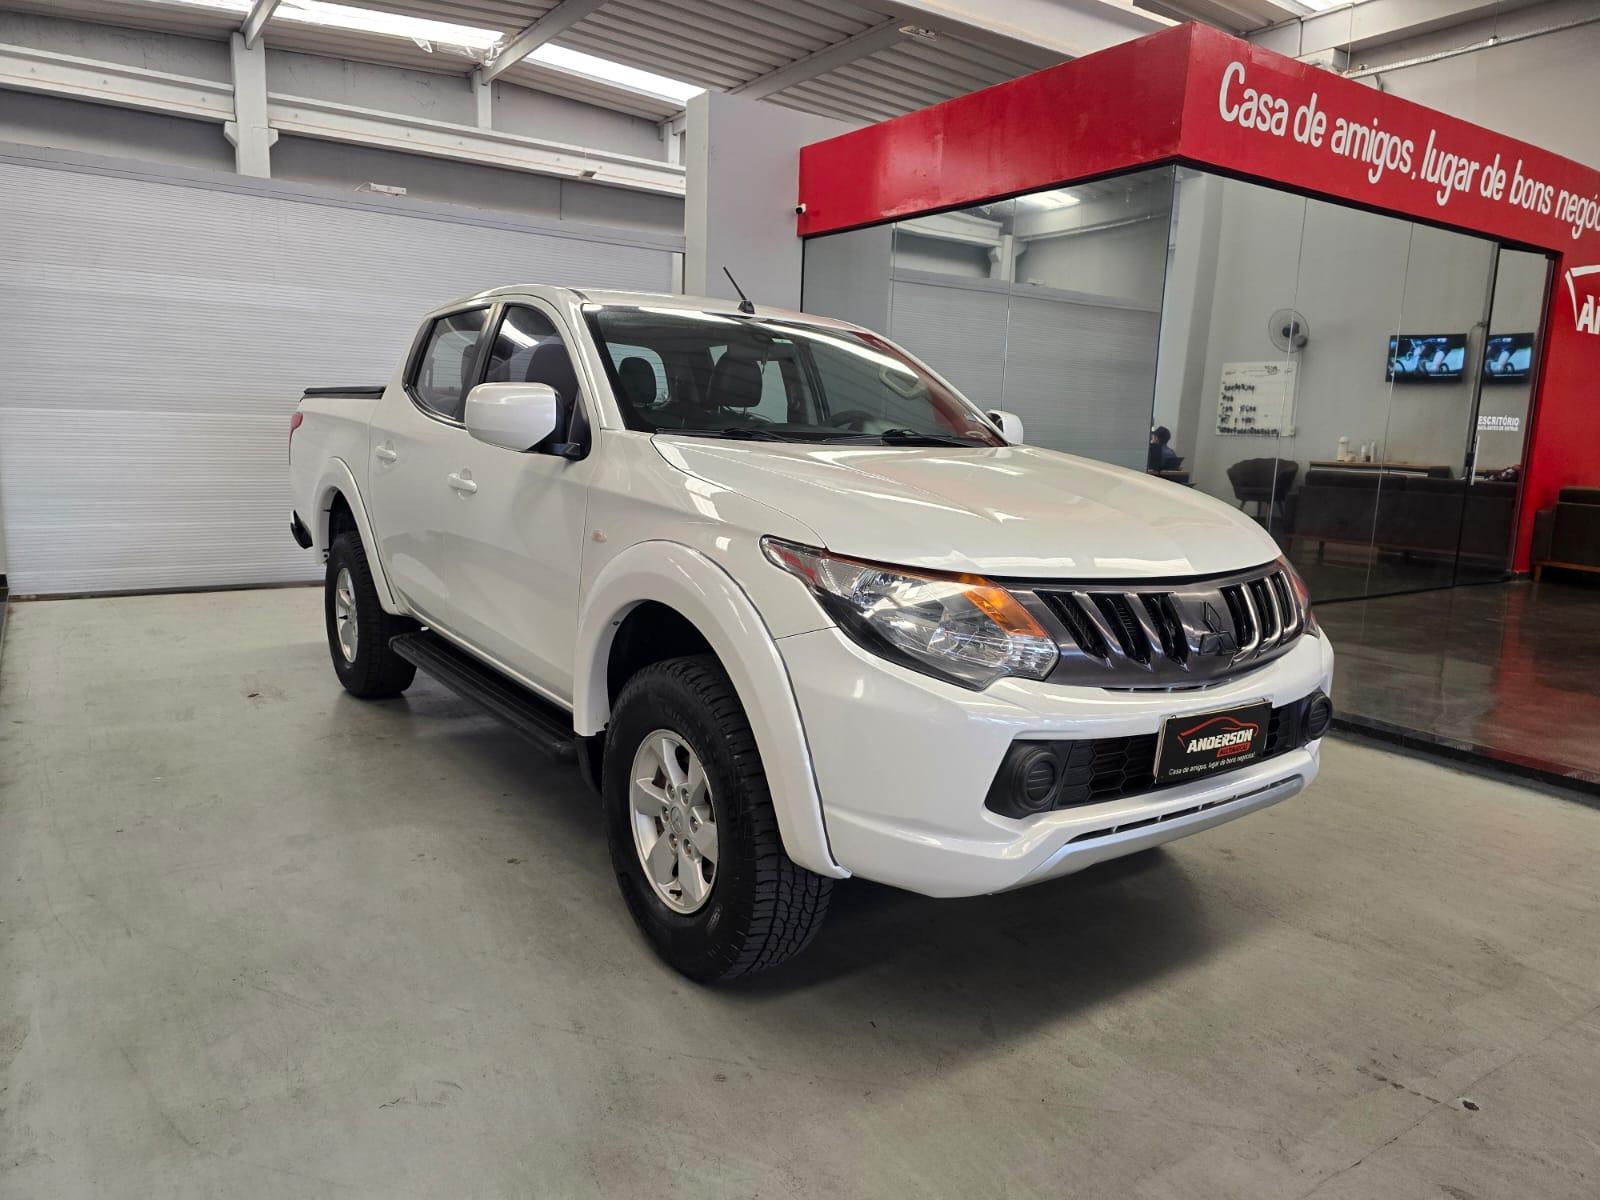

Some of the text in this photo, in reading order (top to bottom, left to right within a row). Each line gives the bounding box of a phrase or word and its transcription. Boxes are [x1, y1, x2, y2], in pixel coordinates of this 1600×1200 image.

[1219, 61, 1289, 137] Casa
[1293, 92, 1327, 148] de
[1330, 117, 1416, 184] amigos,
[1420, 128, 1480, 206] lugar
[1480, 153, 1507, 201] de
[1509, 159, 1554, 215] bons
[1478, 414, 1520, 426] ESCRITÓRIO
[1186, 728, 1254, 753] ANDERSON
